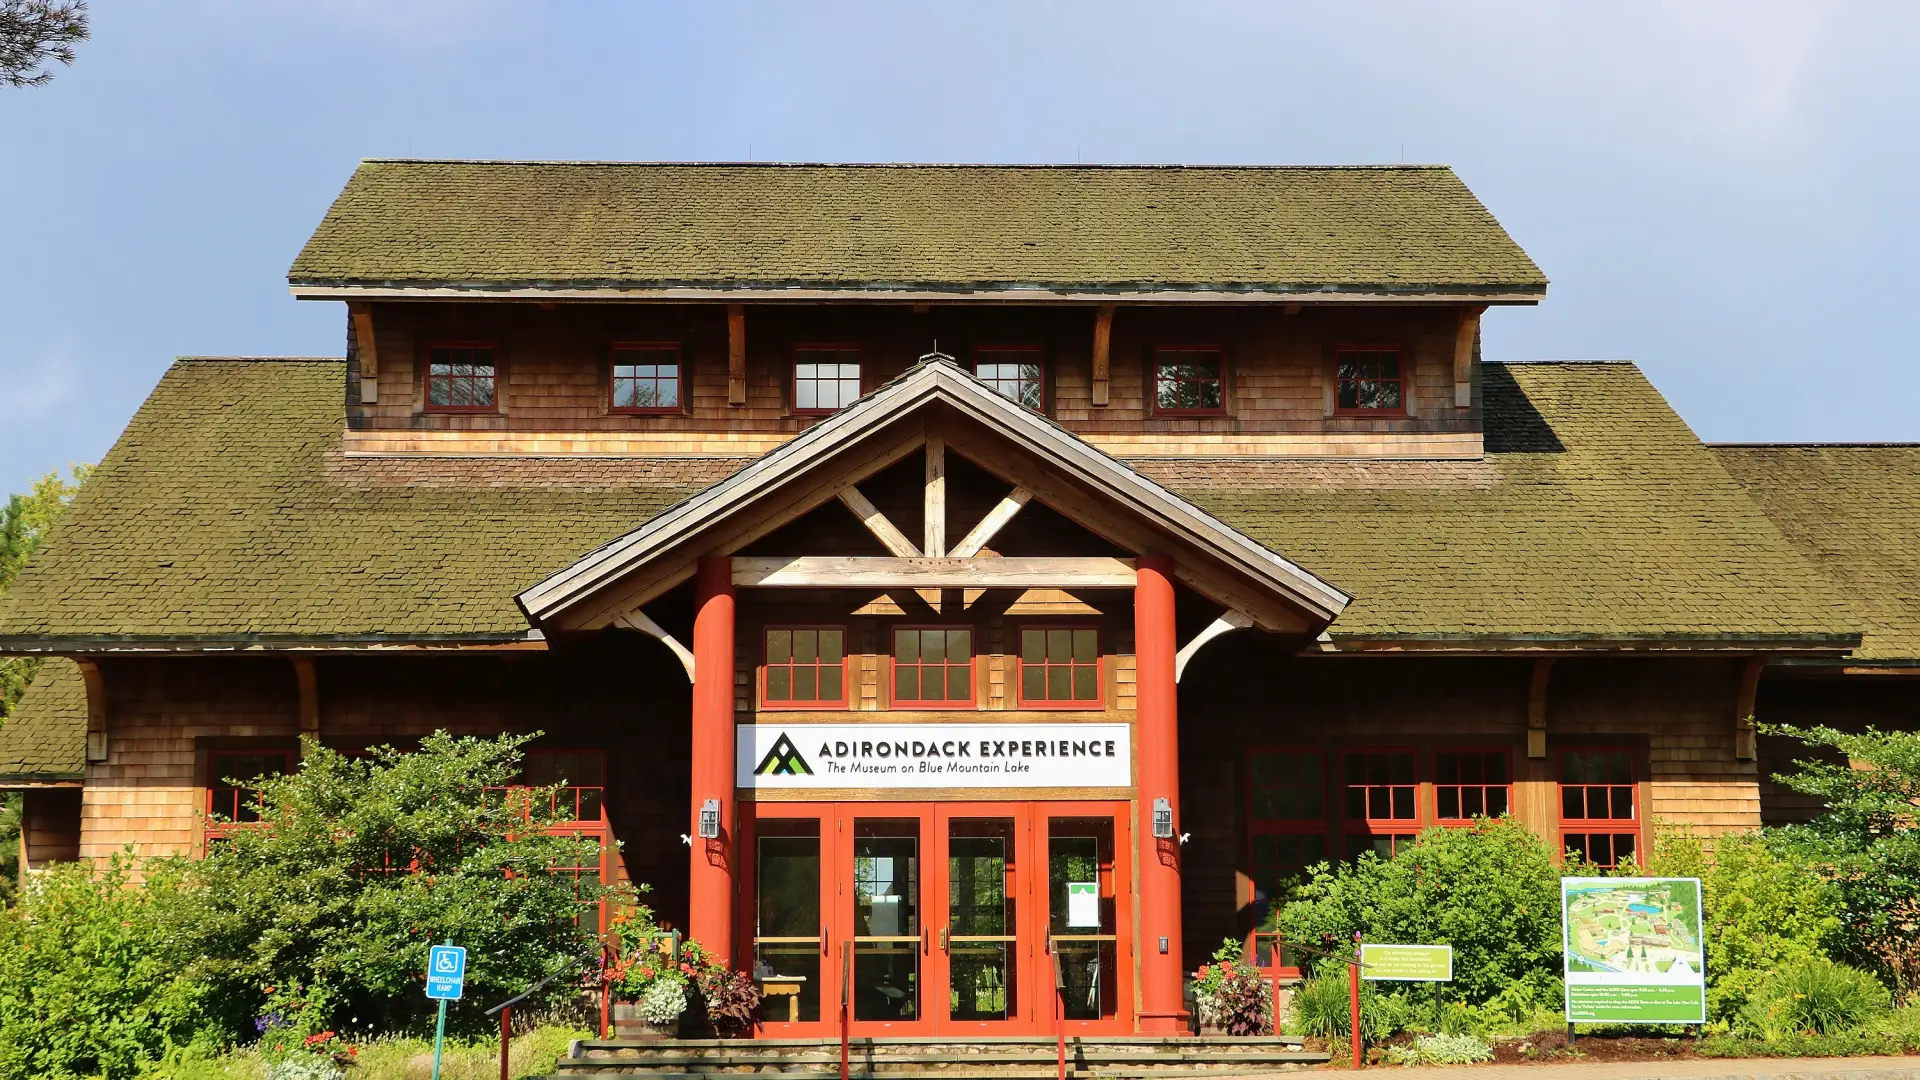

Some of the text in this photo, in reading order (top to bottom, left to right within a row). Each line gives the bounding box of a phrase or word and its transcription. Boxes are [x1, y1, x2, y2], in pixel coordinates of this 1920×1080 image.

[818, 740, 1116, 758] ADIRONDACK EXPERIENCE
[827, 760, 1030, 773] The Museum on Blue Mountain Lake
[429, 976, 461, 984] WHEELCHAIR
[436, 984, 453, 992] RAMP
